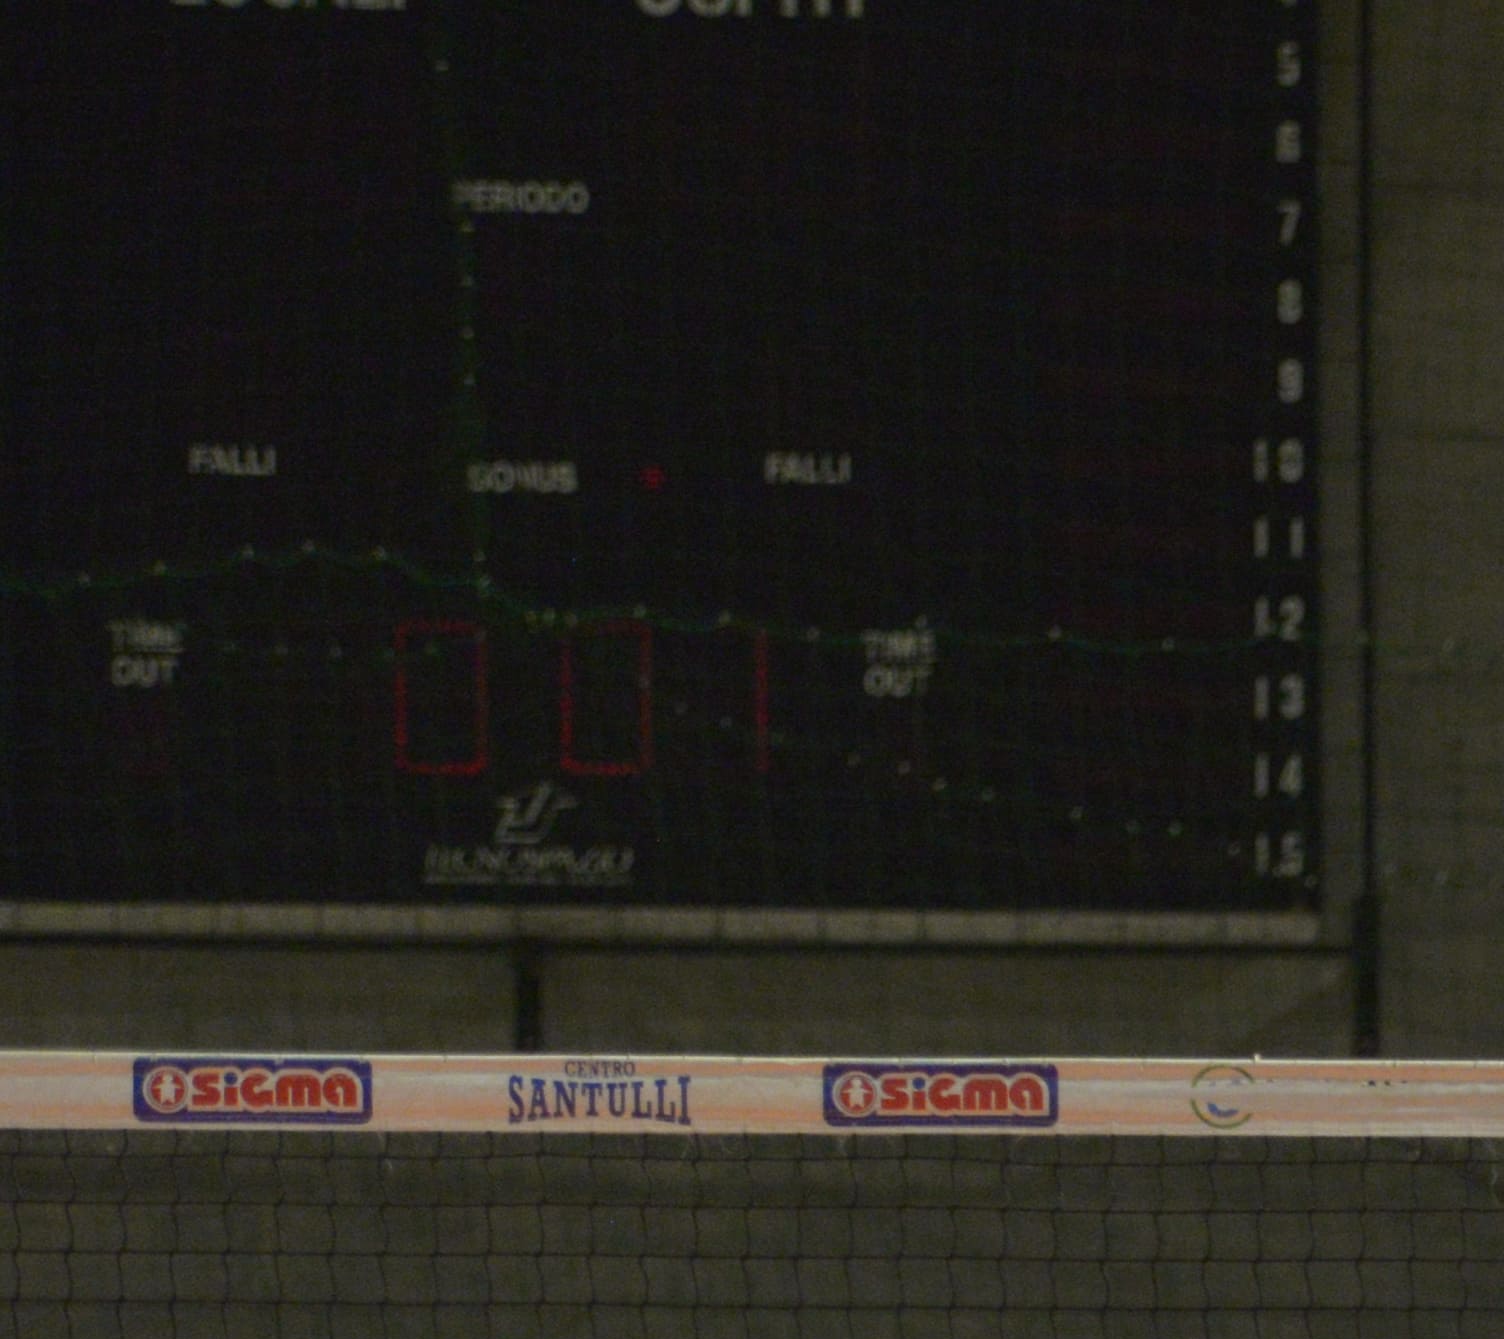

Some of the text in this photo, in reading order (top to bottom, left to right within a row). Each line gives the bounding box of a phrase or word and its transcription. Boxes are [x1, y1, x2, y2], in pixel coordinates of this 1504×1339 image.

[452, 181, 590, 214] PERIODO
[1276, 203, 1301, 248] 7
[188, 444, 276, 476] FALLI
[466, 460, 578, 494] BONUS
[764, 451, 852, 484] FALLI
[1252, 516, 1304, 558] 11
[111, 657, 180, 688] OUT
[1252, 673, 1304, 720] 13
[1252, 753, 1304, 799] 14
[1252, 831, 1304, 877] 15
[564, 1061, 636, 1077] CENTRO
[508, 1075, 692, 1127] SANTULLI
